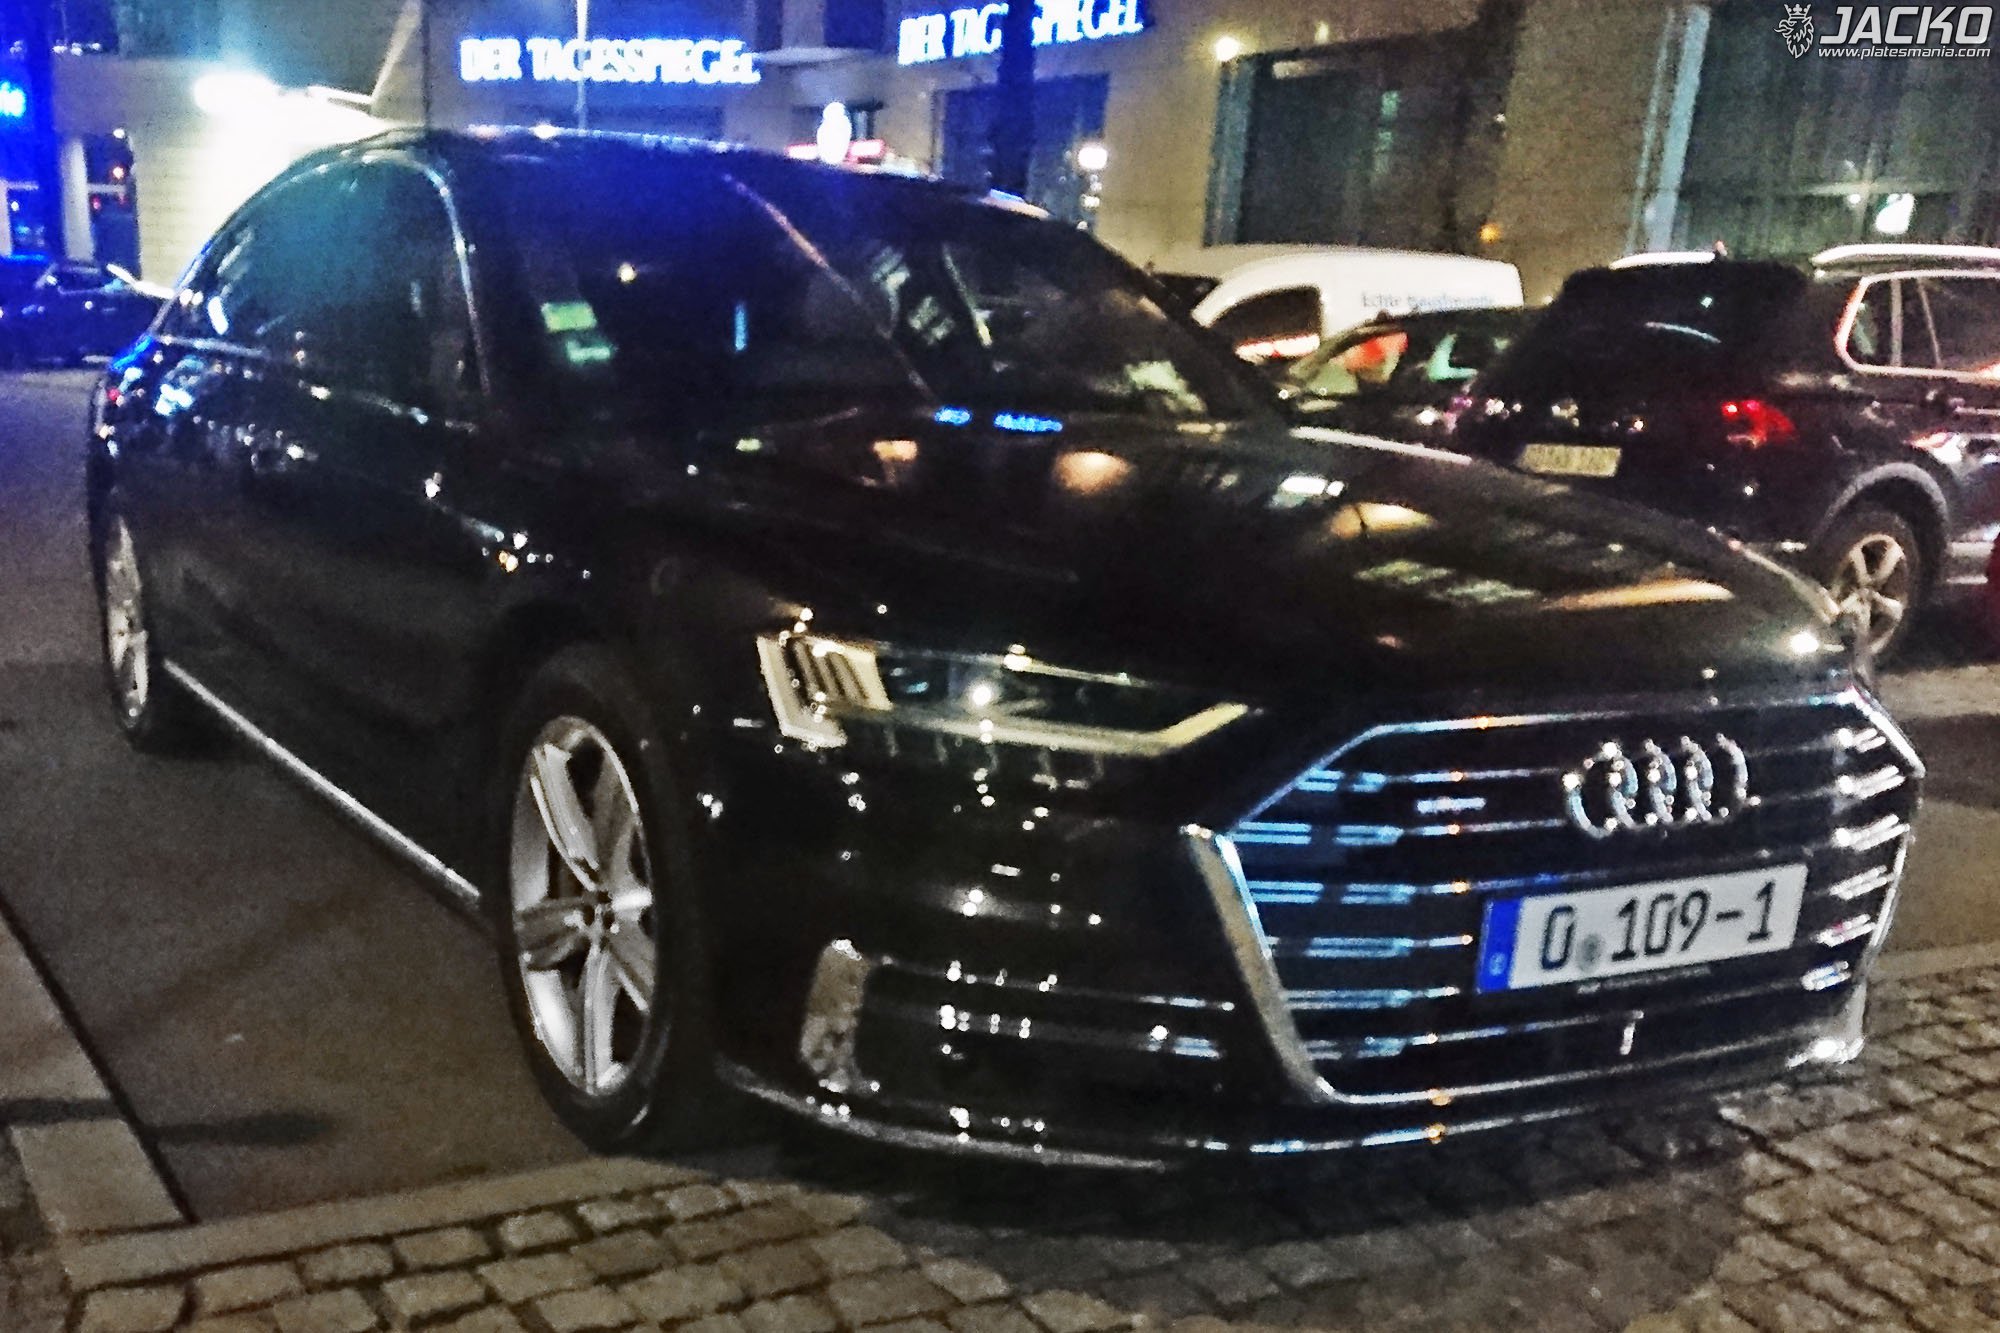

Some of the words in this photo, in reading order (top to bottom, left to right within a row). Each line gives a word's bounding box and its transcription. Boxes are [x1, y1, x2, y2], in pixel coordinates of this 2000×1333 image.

[460, 38, 522, 82] DER
[526, 38, 761, 84] TAGESSPIEGEL
[898, 14, 947, 66] DER
[1612, 878, 1776, 962] 109-1
